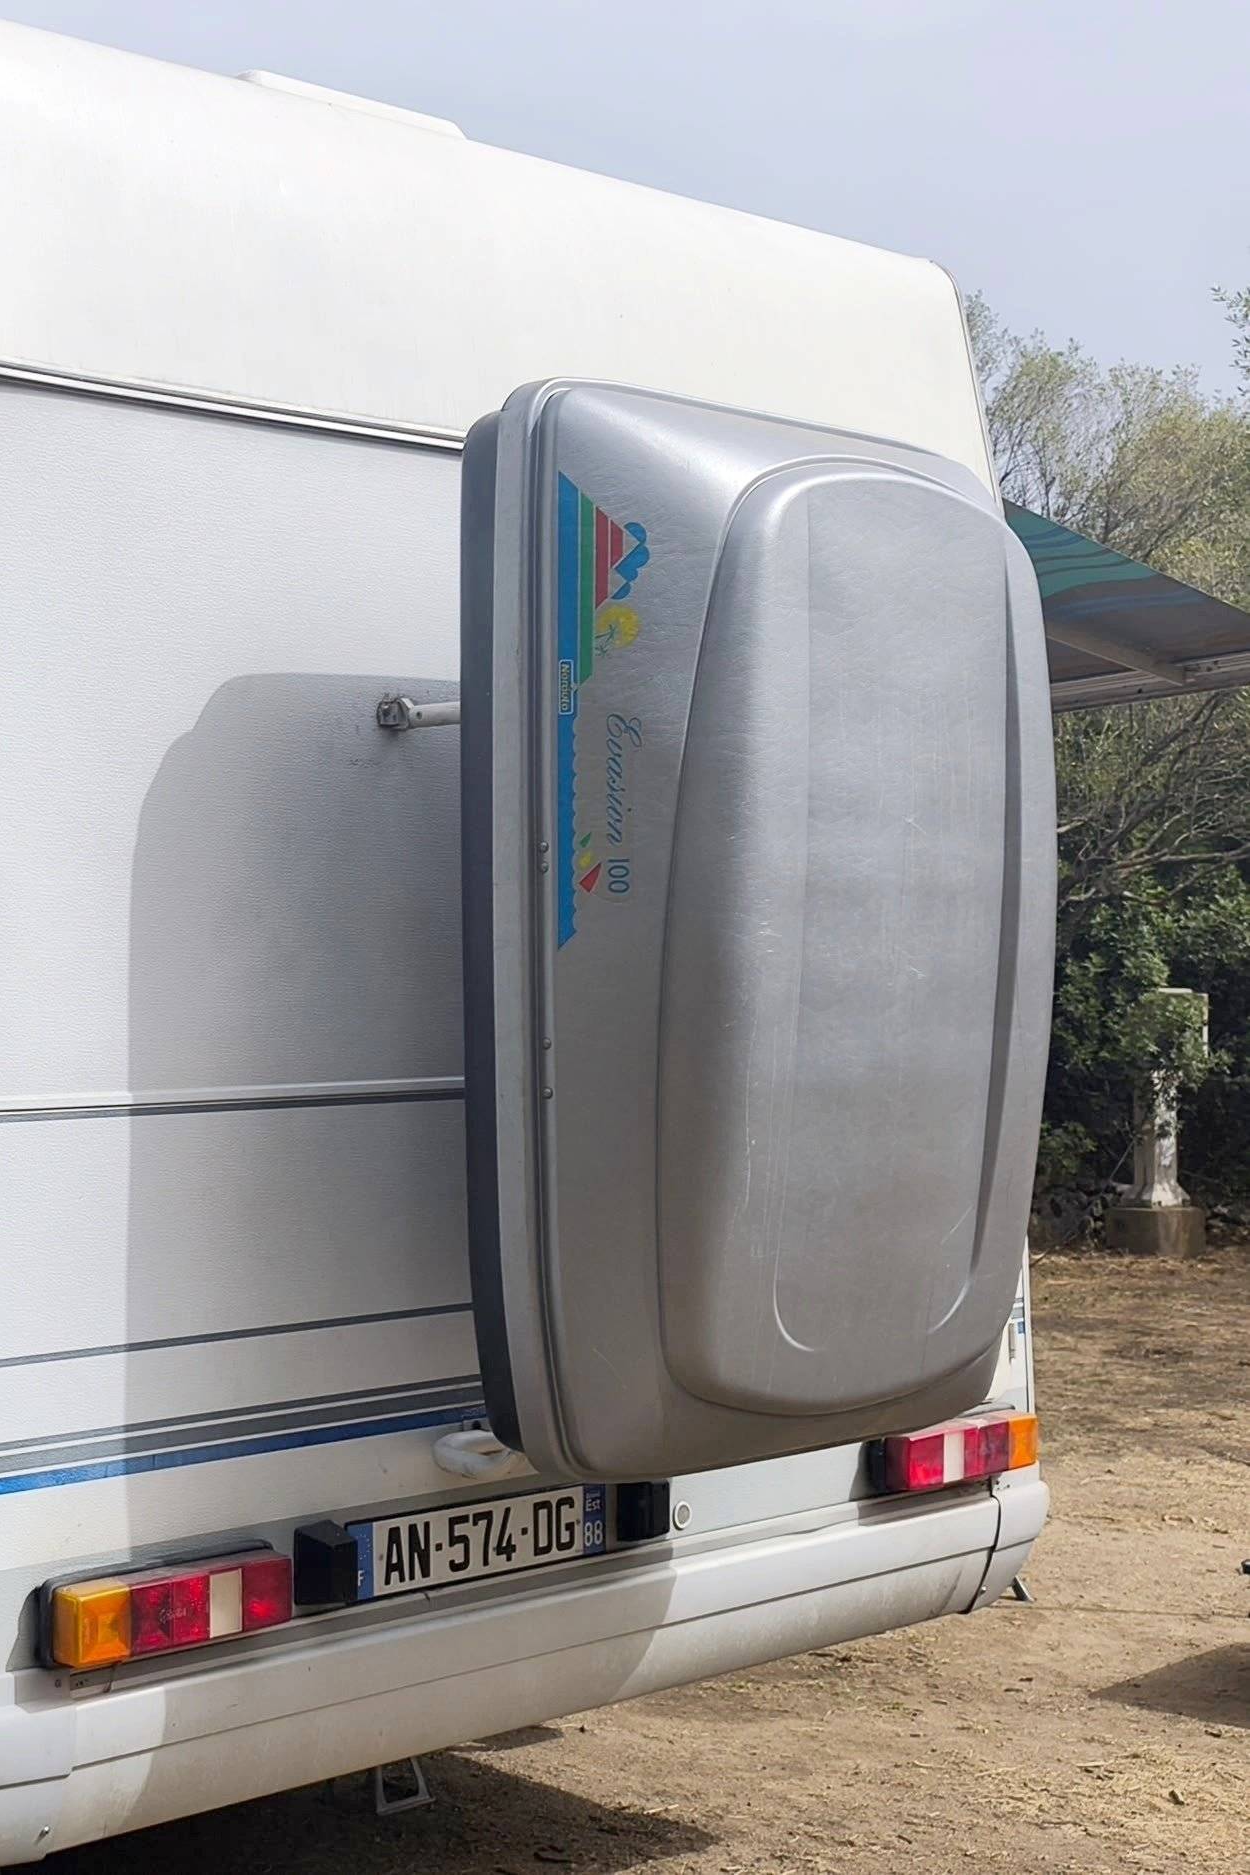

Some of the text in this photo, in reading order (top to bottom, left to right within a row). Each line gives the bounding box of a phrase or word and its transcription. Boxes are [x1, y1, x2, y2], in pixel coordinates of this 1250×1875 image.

[606, 713, 643, 894] Evasion 100
[384, 1495, 576, 1586] AN-574-DG
[584, 1520, 603, 1547] 88
[357, 1569, 365, 1587] F
